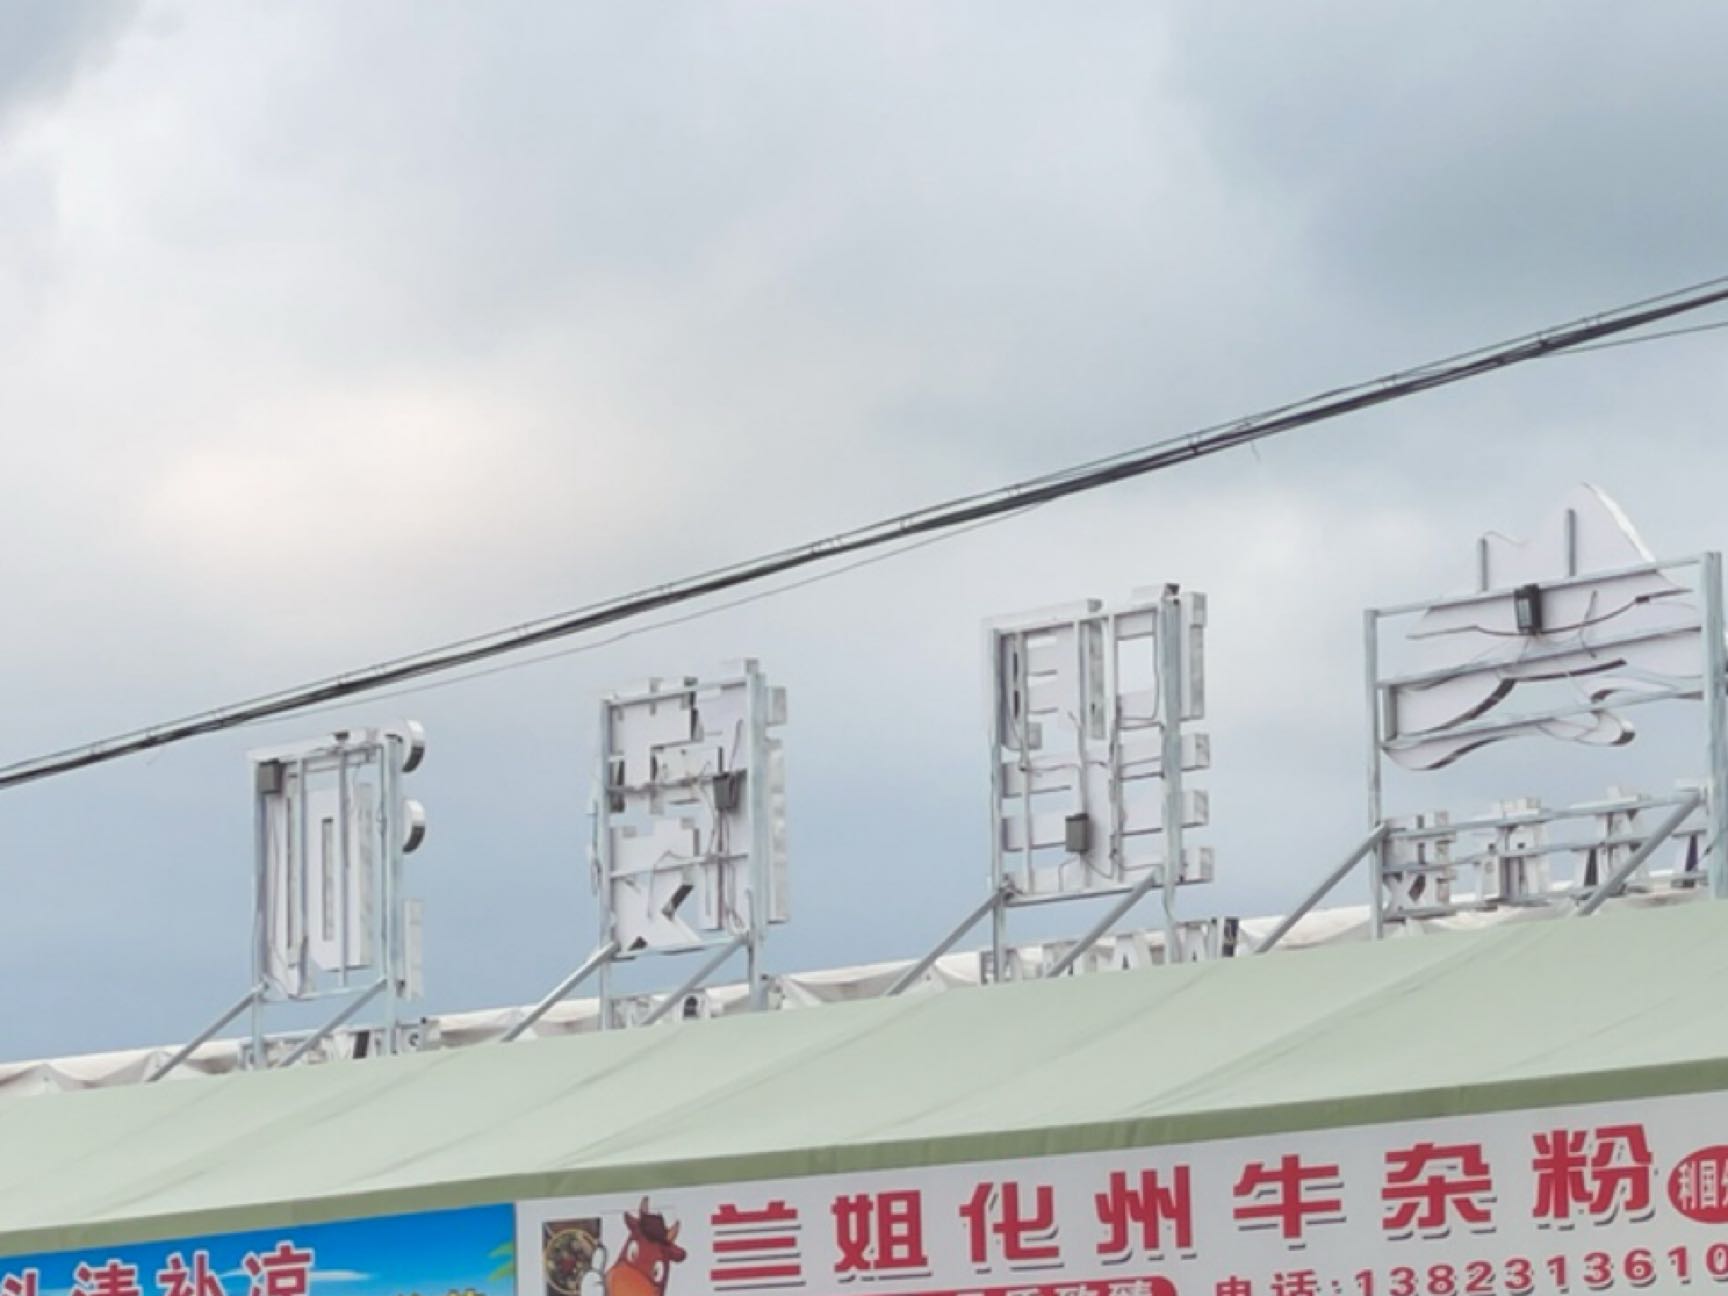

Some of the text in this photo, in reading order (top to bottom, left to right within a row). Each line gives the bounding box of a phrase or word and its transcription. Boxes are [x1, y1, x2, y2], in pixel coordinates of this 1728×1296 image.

[710, 1124, 1653, 1282] 兰姐化州牛杂粉
